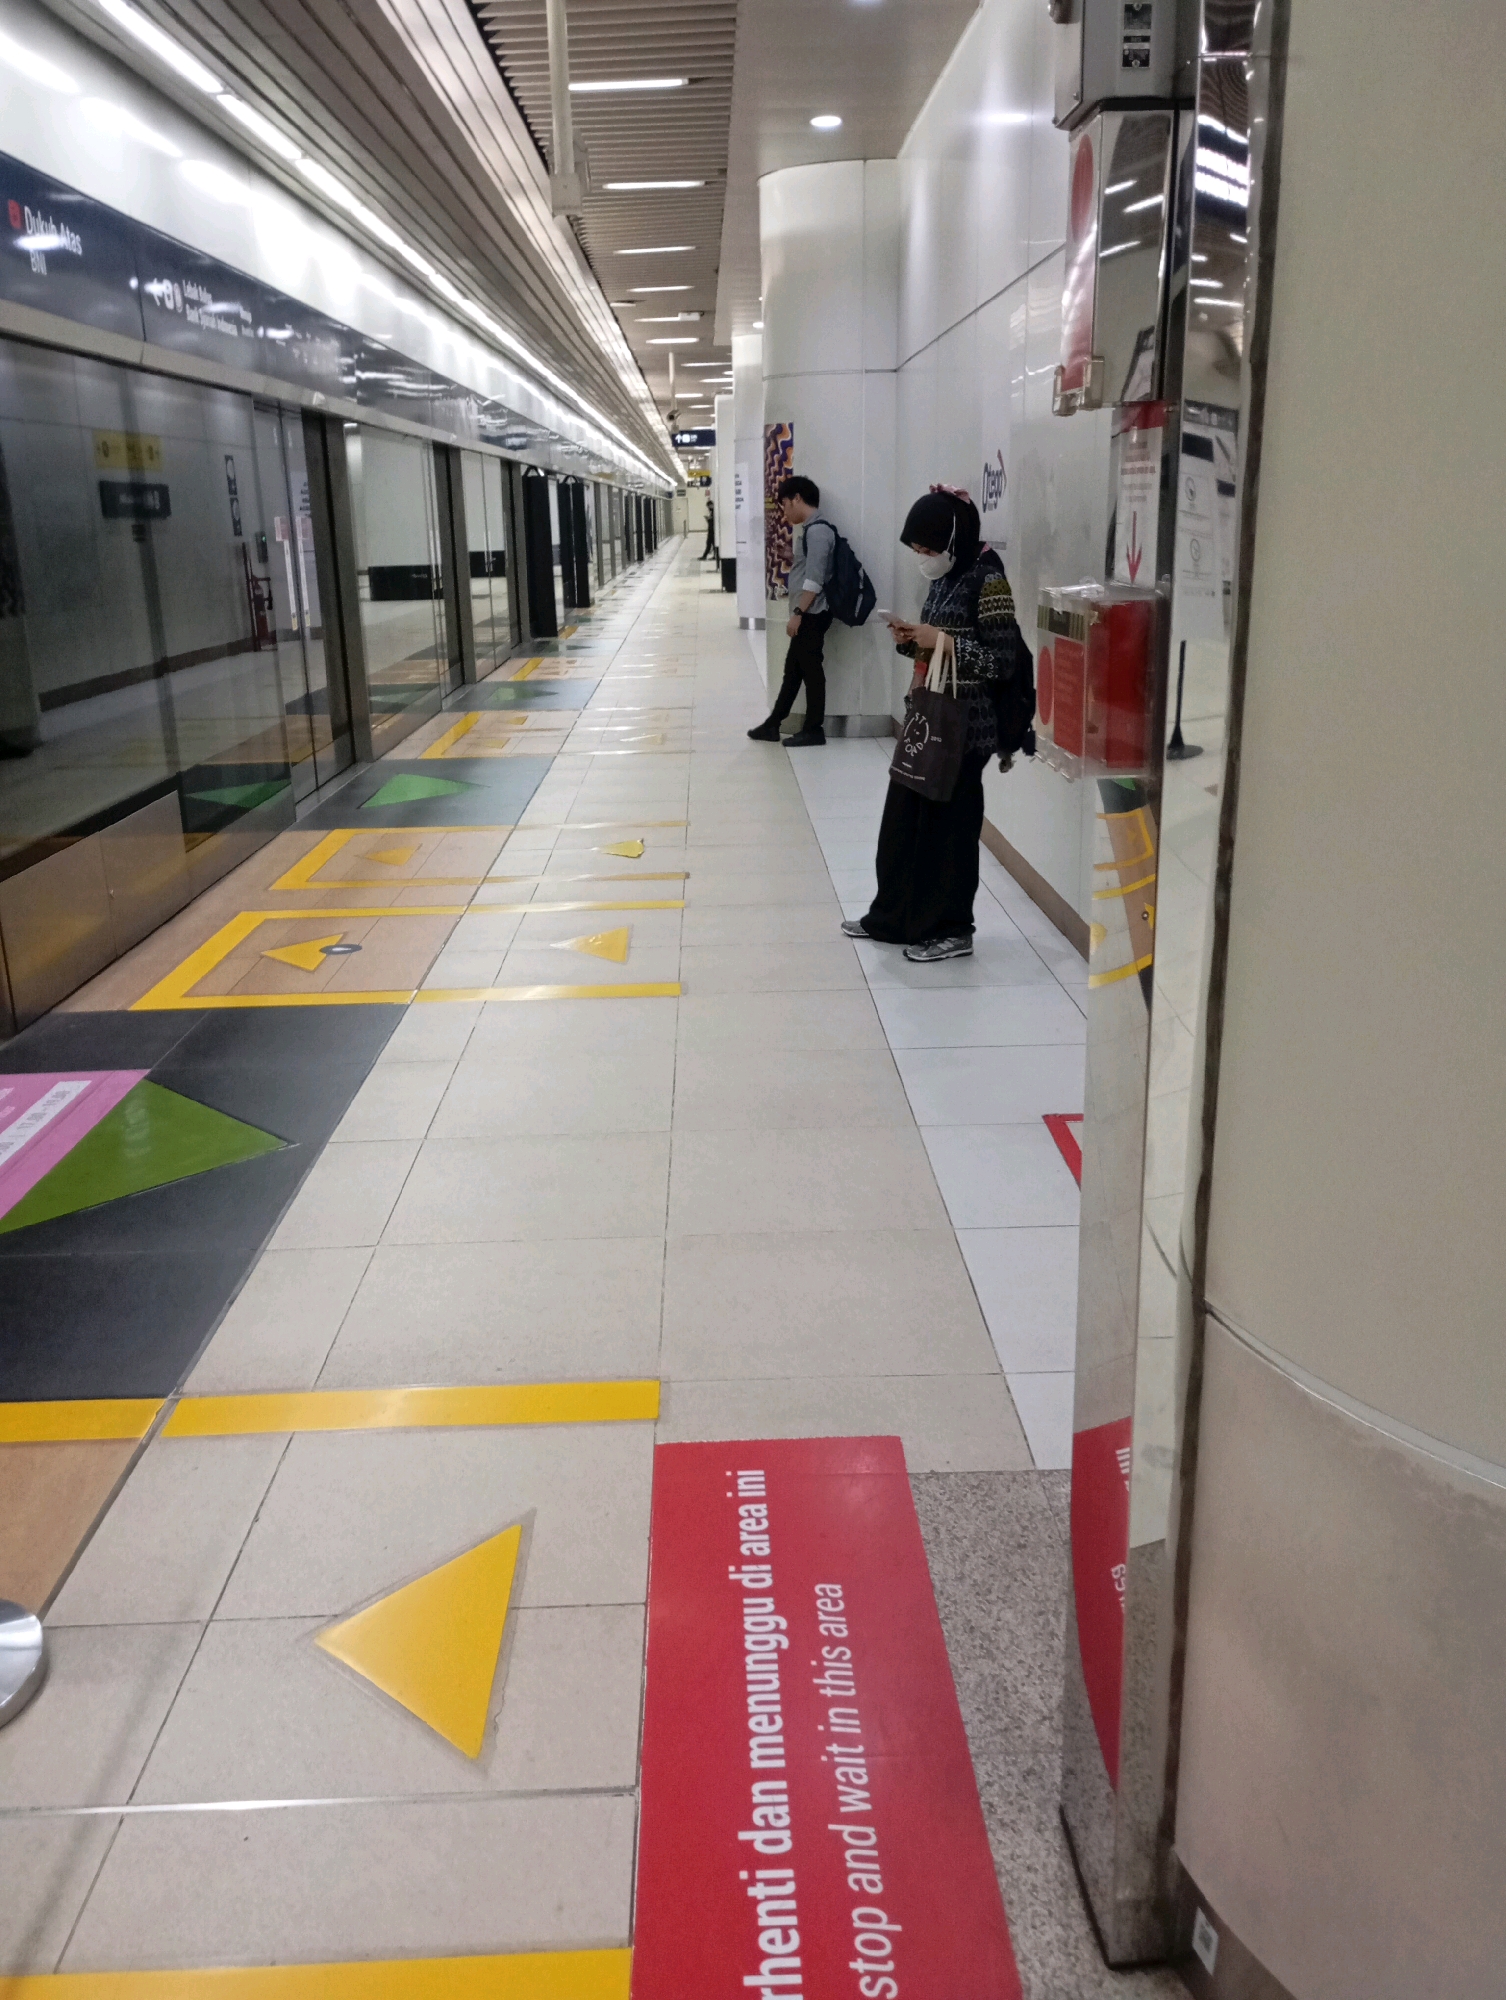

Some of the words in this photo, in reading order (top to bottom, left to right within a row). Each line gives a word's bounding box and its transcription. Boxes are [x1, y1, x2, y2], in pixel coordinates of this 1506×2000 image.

[60, 222, 82, 256] Atas
[725, 1469, 767, 1498] ini
[738, 1503, 771, 1558] area
[729, 1564, 772, 1589] di
[814, 1583, 845, 1639] area
[742, 1598, 789, 1769] menunggu
[810, 1645, 856, 1698] this
[816, 1707, 862, 1734] in
[819, 1742, 873, 1813] wait
[738, 1781, 794, 1855] dan
[827, 1824, 885, 1894] and
[847, 1906, 902, 2000] stop
